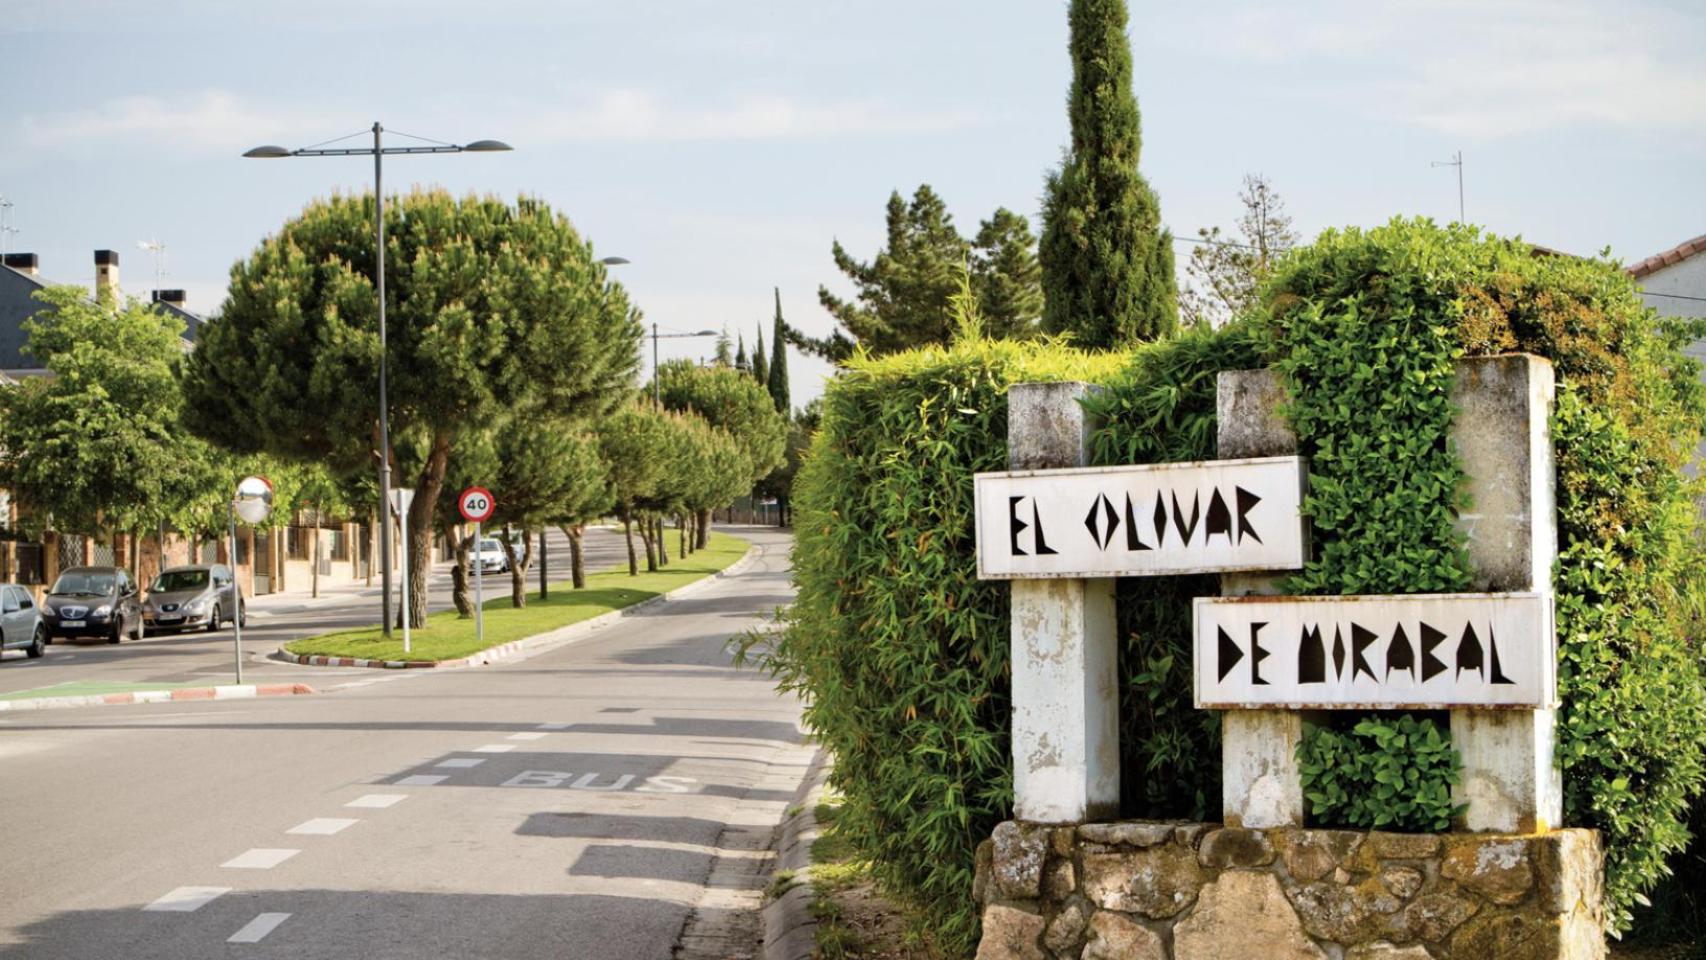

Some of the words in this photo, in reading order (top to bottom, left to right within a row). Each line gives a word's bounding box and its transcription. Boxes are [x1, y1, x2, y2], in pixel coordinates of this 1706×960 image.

[466, 499, 487, 510] 40
[1009, 496, 1059, 556] EL
[1084, 485, 1263, 552] OLIVAR
[1217, 622, 1271, 685] DE
[1298, 619, 1517, 685] MIRABAL
[500, 770, 697, 793] BUS
